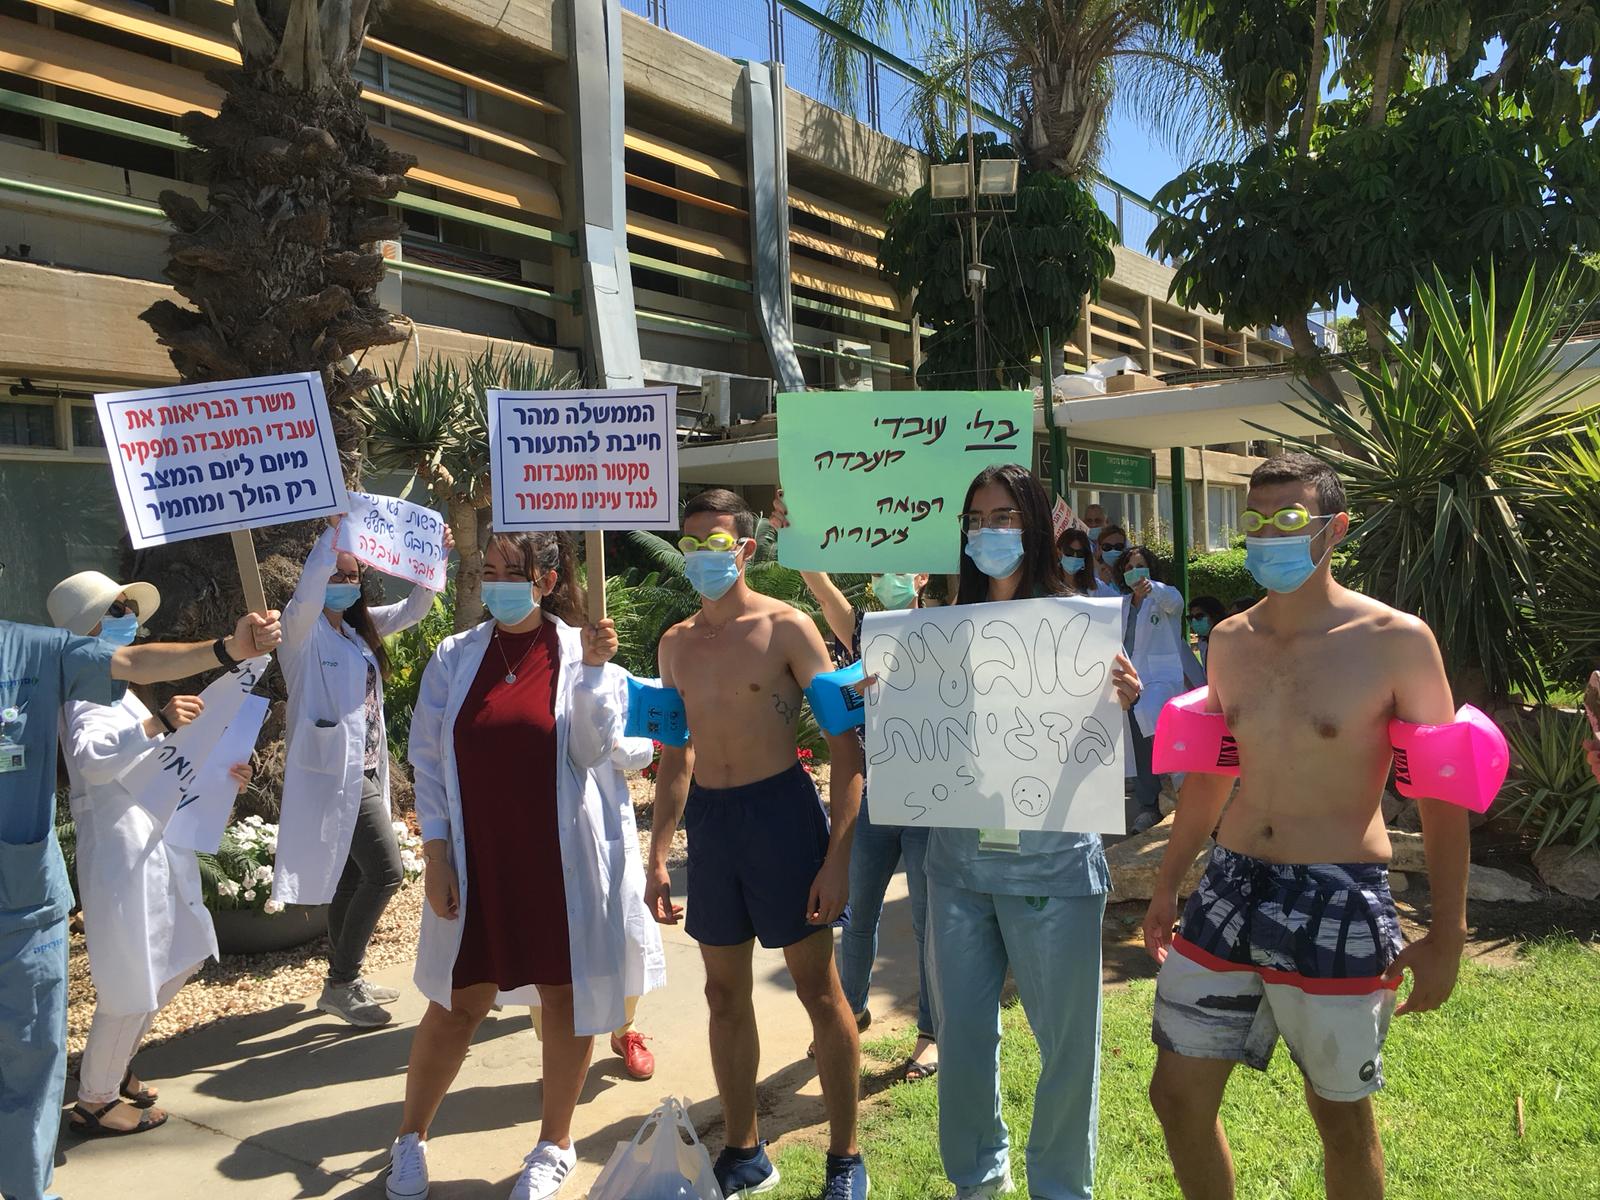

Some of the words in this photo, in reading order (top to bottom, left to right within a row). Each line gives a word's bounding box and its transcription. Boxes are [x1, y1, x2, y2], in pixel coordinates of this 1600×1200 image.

[158, 398, 238, 425] הבריאות
[242, 391, 295, 415] משרד
[565, 402, 655, 425] הממשלה
[125, 409, 155, 430] את
[513, 407, 560, 425] מהר
[966, 408, 1019, 443] בלי
[182, 426, 263, 454] המעבדה
[267, 419, 316, 441] עובדי
[507, 430, 600, 454] להתעורר
[606, 432, 661, 452] חייבת
[873, 415, 947, 446] עובדי
[120, 437, 178, 466] מפקיר
[259, 450, 308, 474] מיום
[814, 449, 906, 473] מעבדה
[141, 466, 204, 491] המצב
[208, 453, 254, 481] ליום
[523, 463, 598, 483] המעבדות
[602, 462, 650, 485] סקטור
[229, 483, 281, 513] הולך
[285, 478, 317, 504] רק
[515, 491, 578, 511] מתפורר
[581, 491, 622, 510] עינינו
[625, 486, 658, 510] לנגד
[146, 493, 224, 521] ומחמיר
[876, 496, 944, 522] רפואה
[820, 526, 910, 550] ציבורית
[359, 535, 400, 566] מעבדה
[408, 558, 436, 580] עובדי
